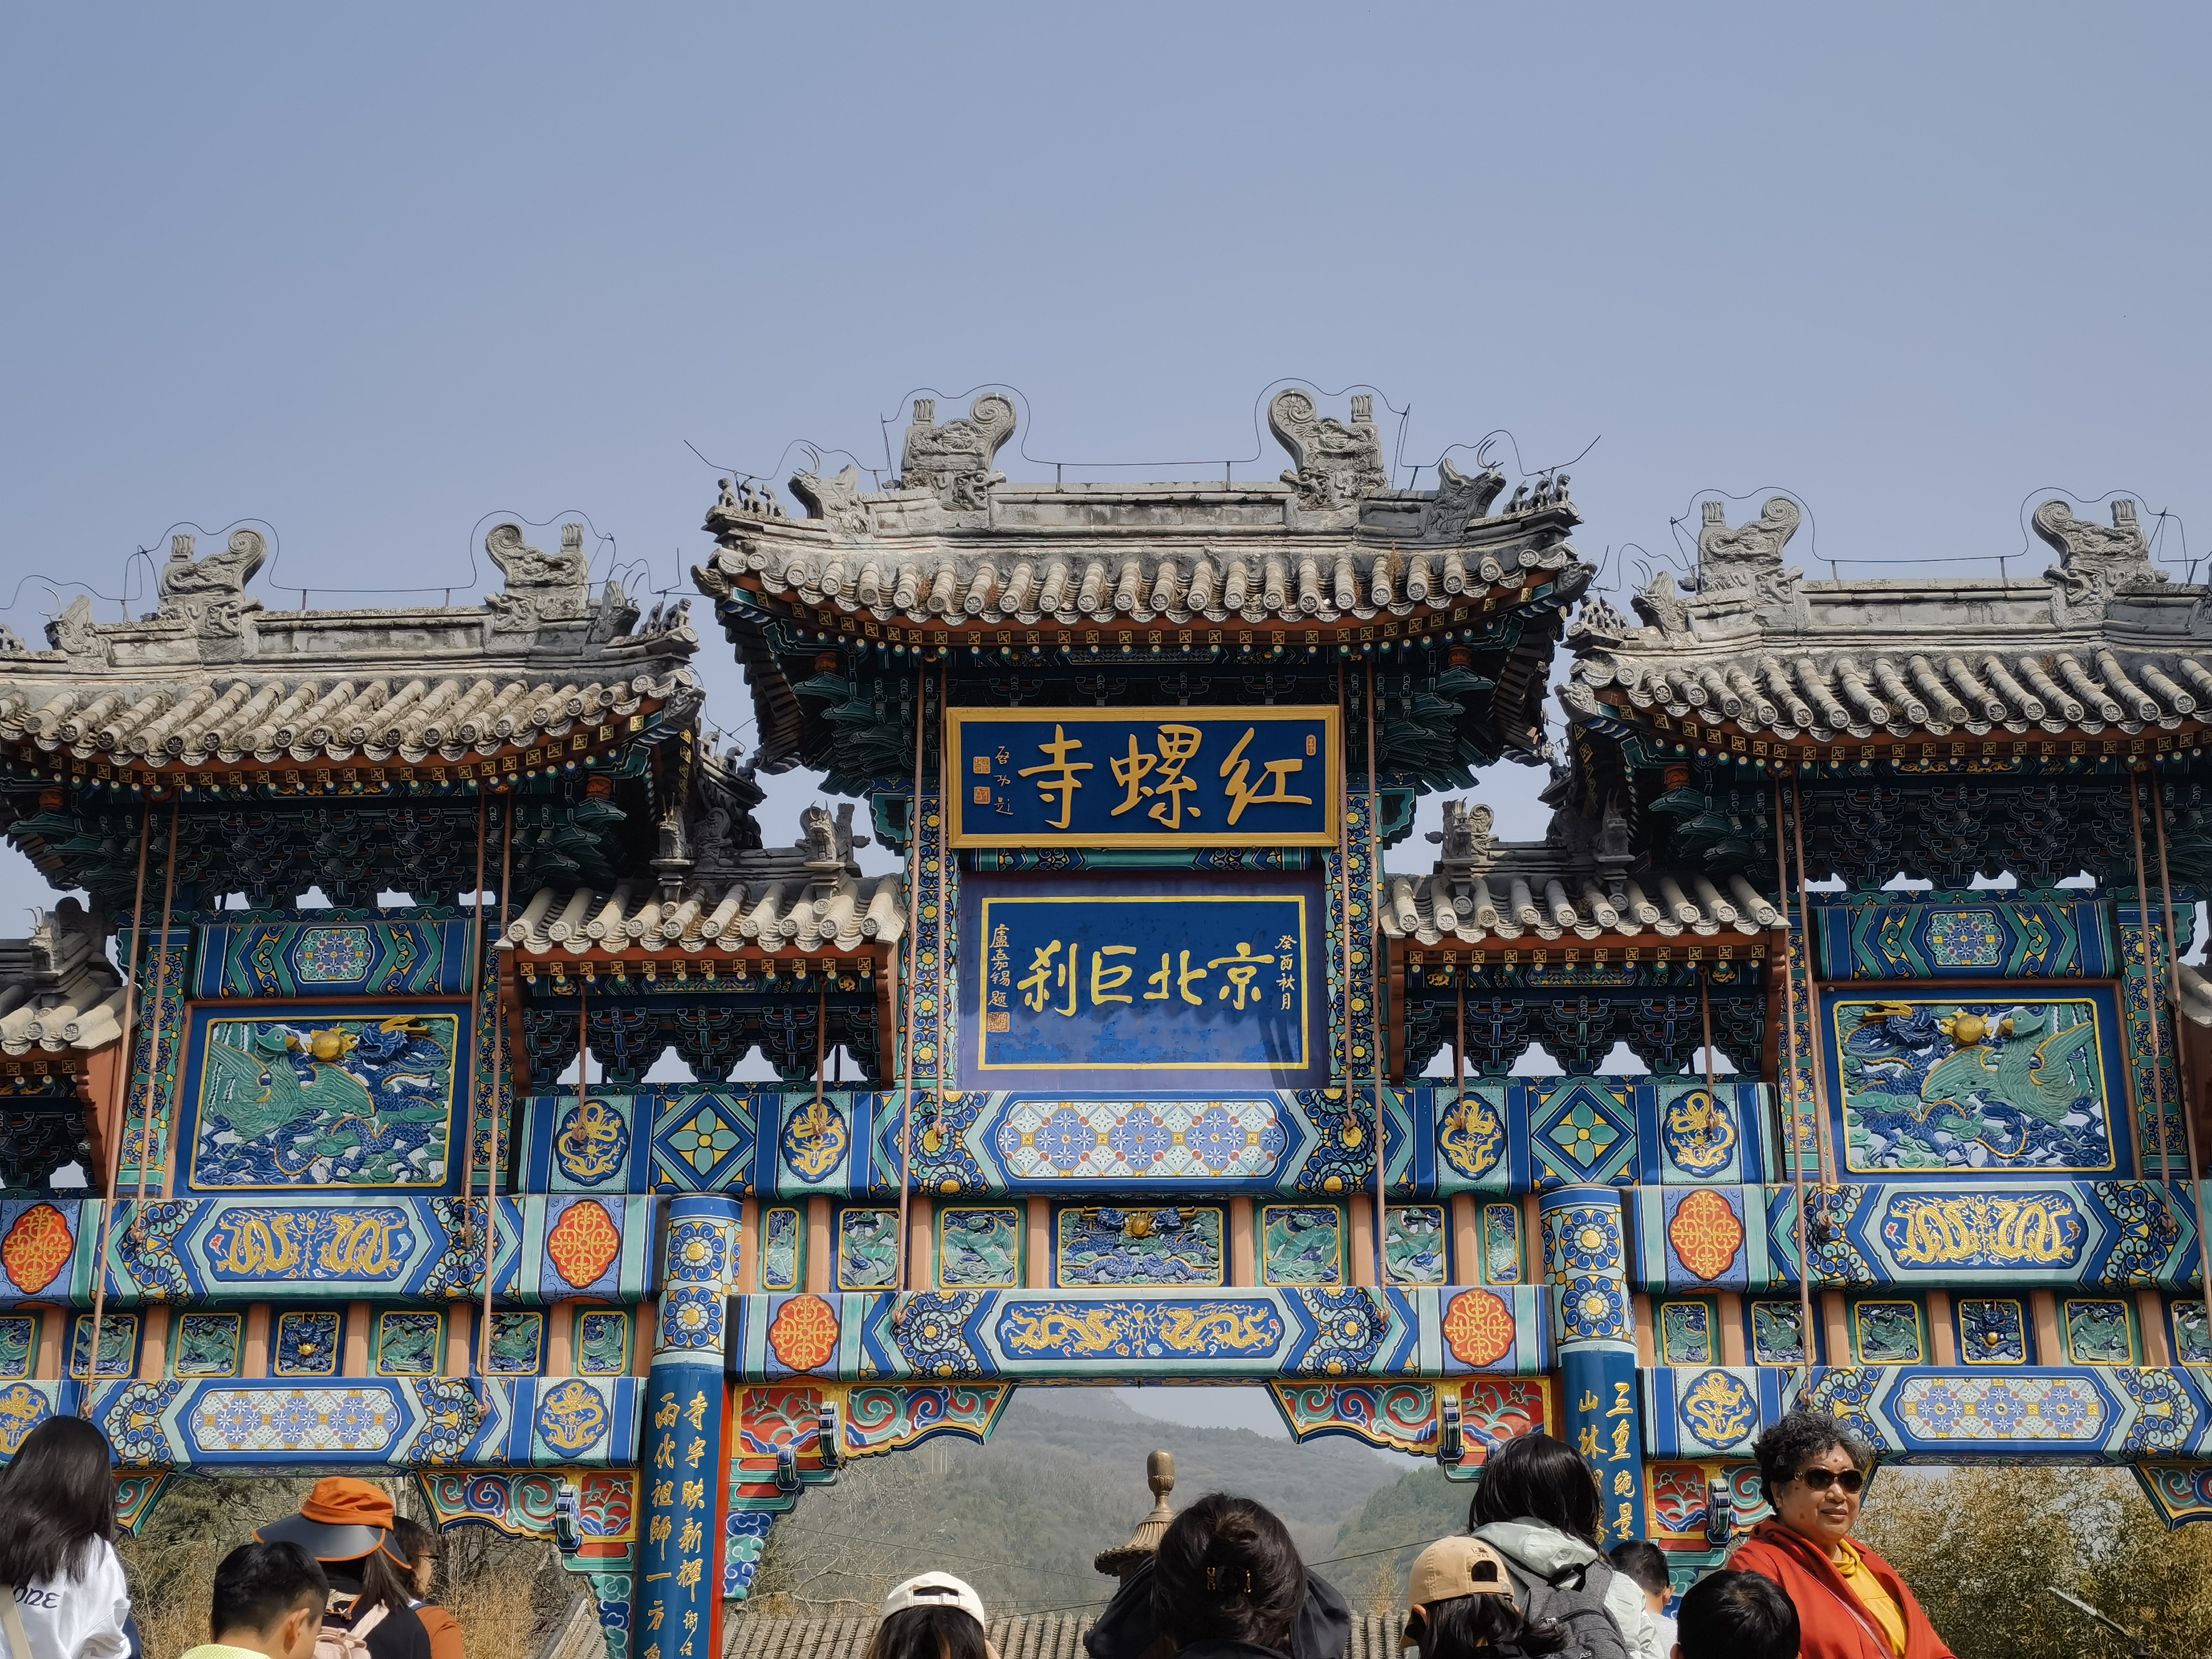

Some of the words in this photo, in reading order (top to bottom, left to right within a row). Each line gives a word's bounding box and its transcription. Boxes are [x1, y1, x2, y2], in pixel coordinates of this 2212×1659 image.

[1018, 724, 1313, 829] 红螺寺
[1017, 940, 1274, 1016] 京北巨刹
[1274, 935, 1297, 1010] 癸酉秋月
